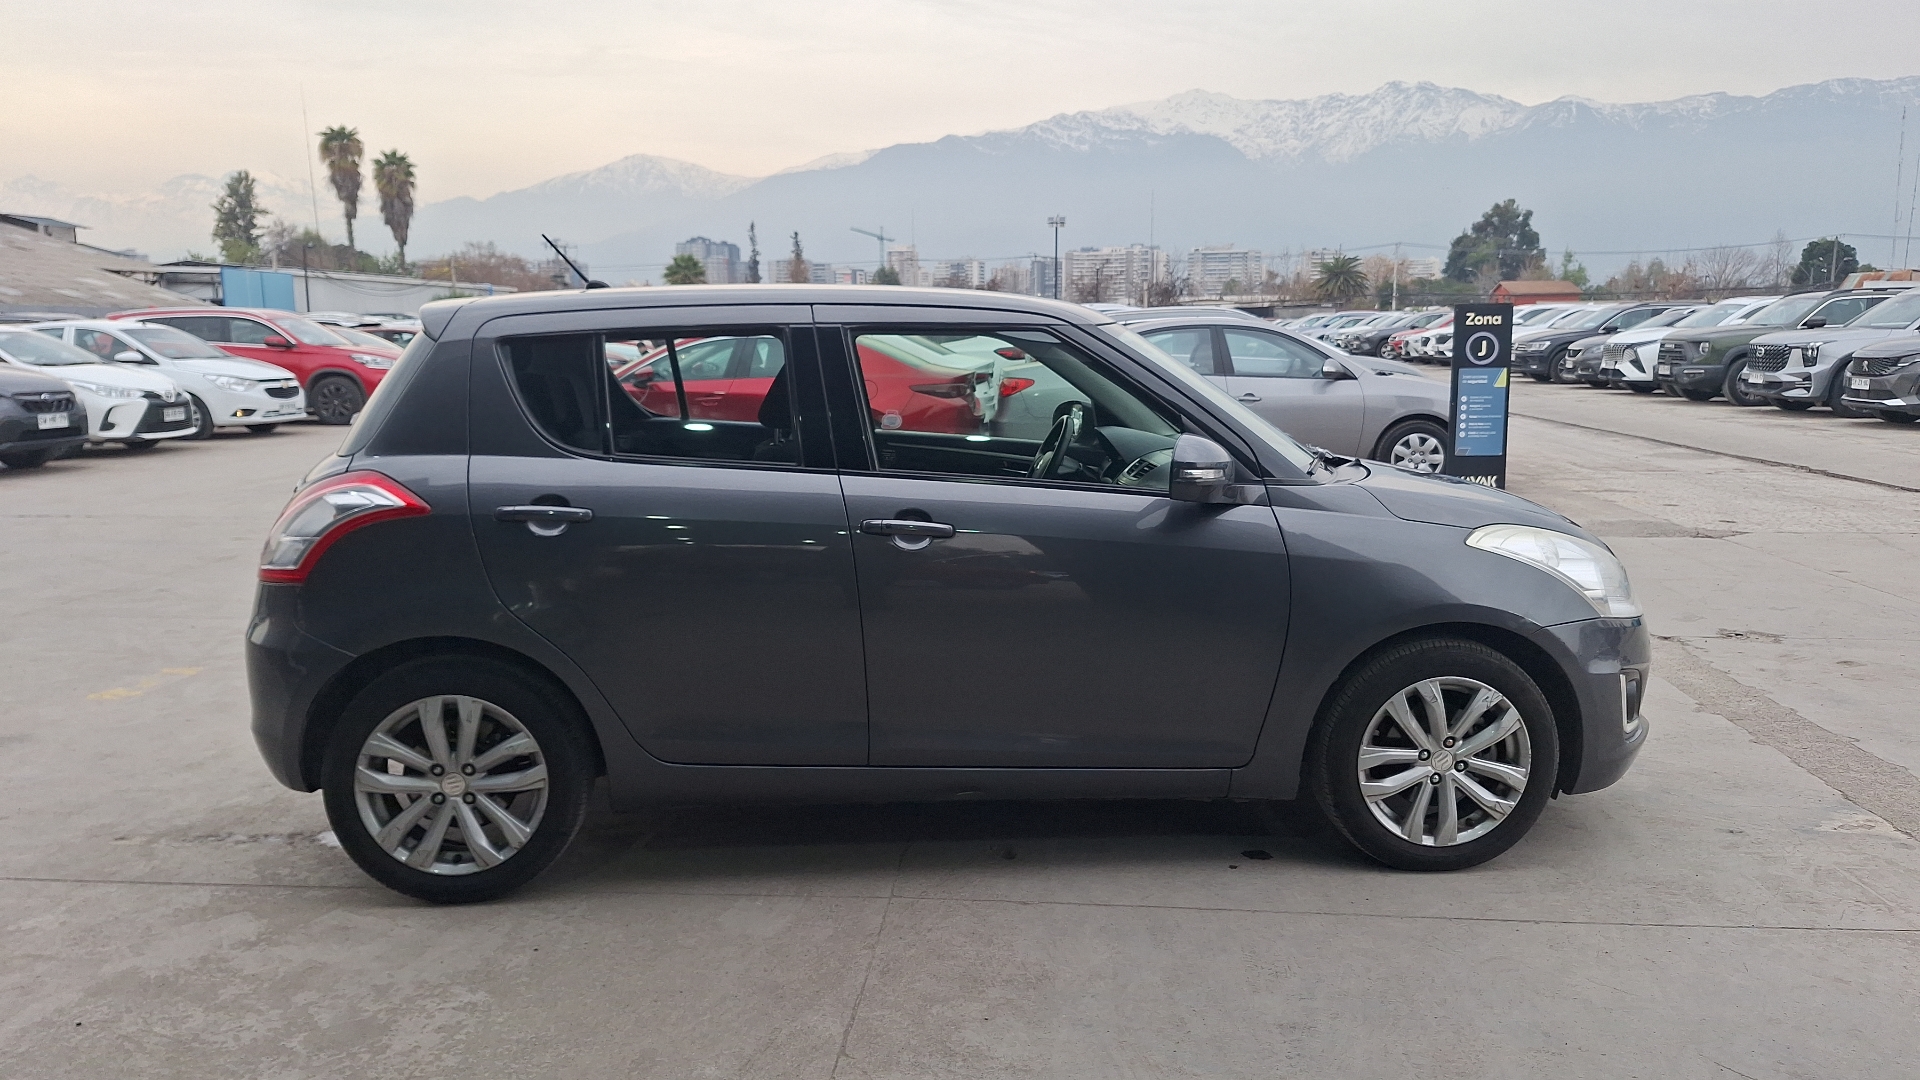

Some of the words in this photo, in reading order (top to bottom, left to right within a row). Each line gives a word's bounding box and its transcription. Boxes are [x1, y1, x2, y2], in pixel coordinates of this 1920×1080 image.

[1465, 312, 1502, 326] Zona
[1477, 340, 1487, 357] J
[1460, 475, 1497, 488] VAK
